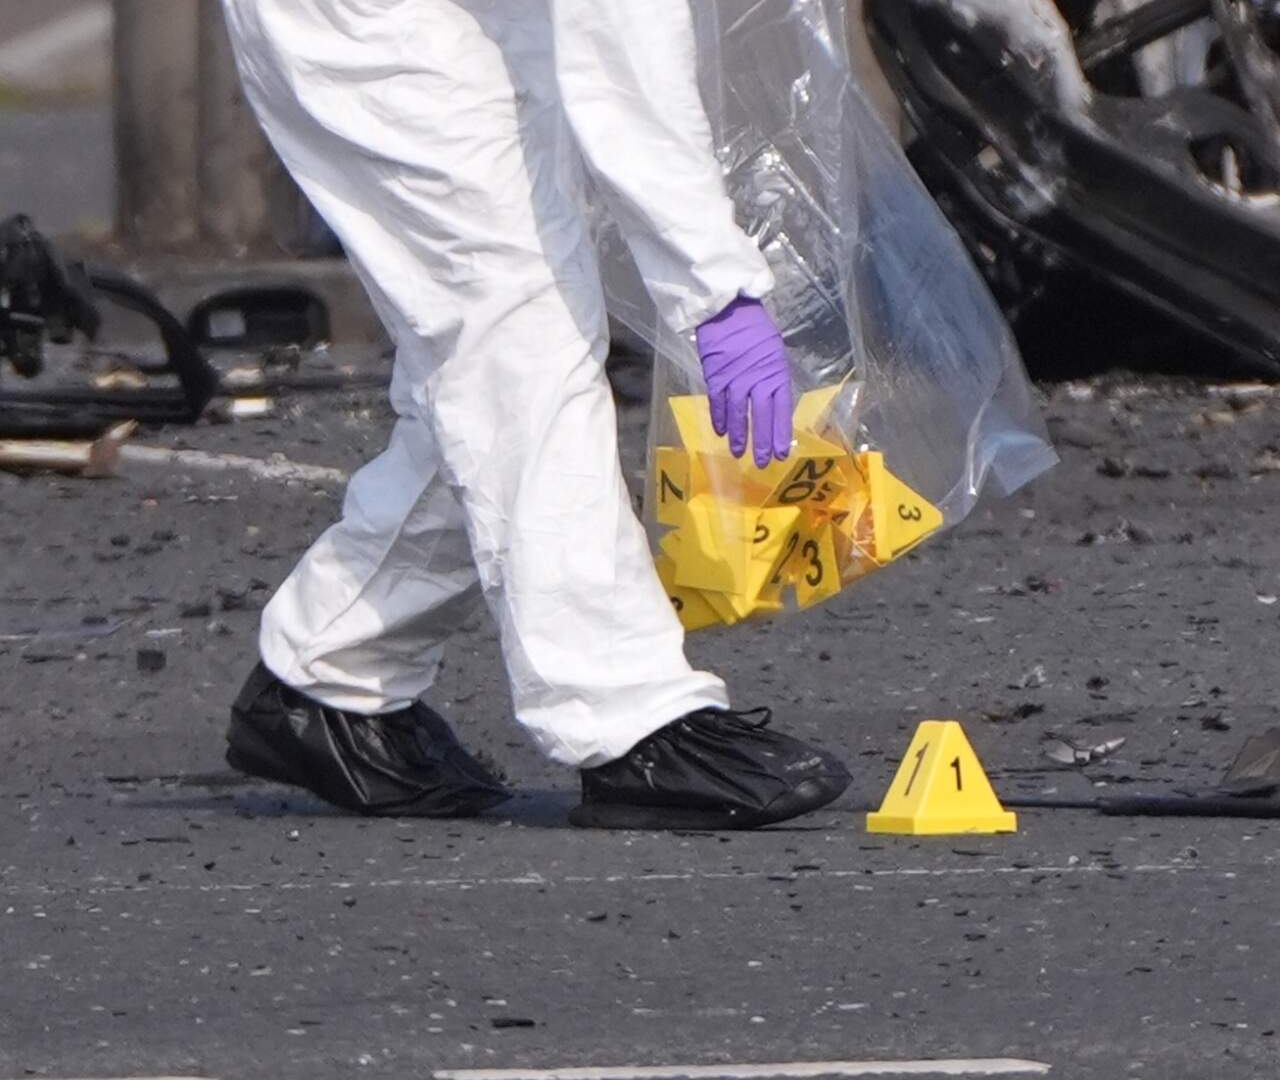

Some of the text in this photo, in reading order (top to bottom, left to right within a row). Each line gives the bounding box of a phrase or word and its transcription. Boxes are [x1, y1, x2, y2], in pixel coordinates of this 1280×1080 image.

[897, 504, 922, 522] 3
[904, 742, 929, 796] 1
[950, 756, 961, 791] 1
